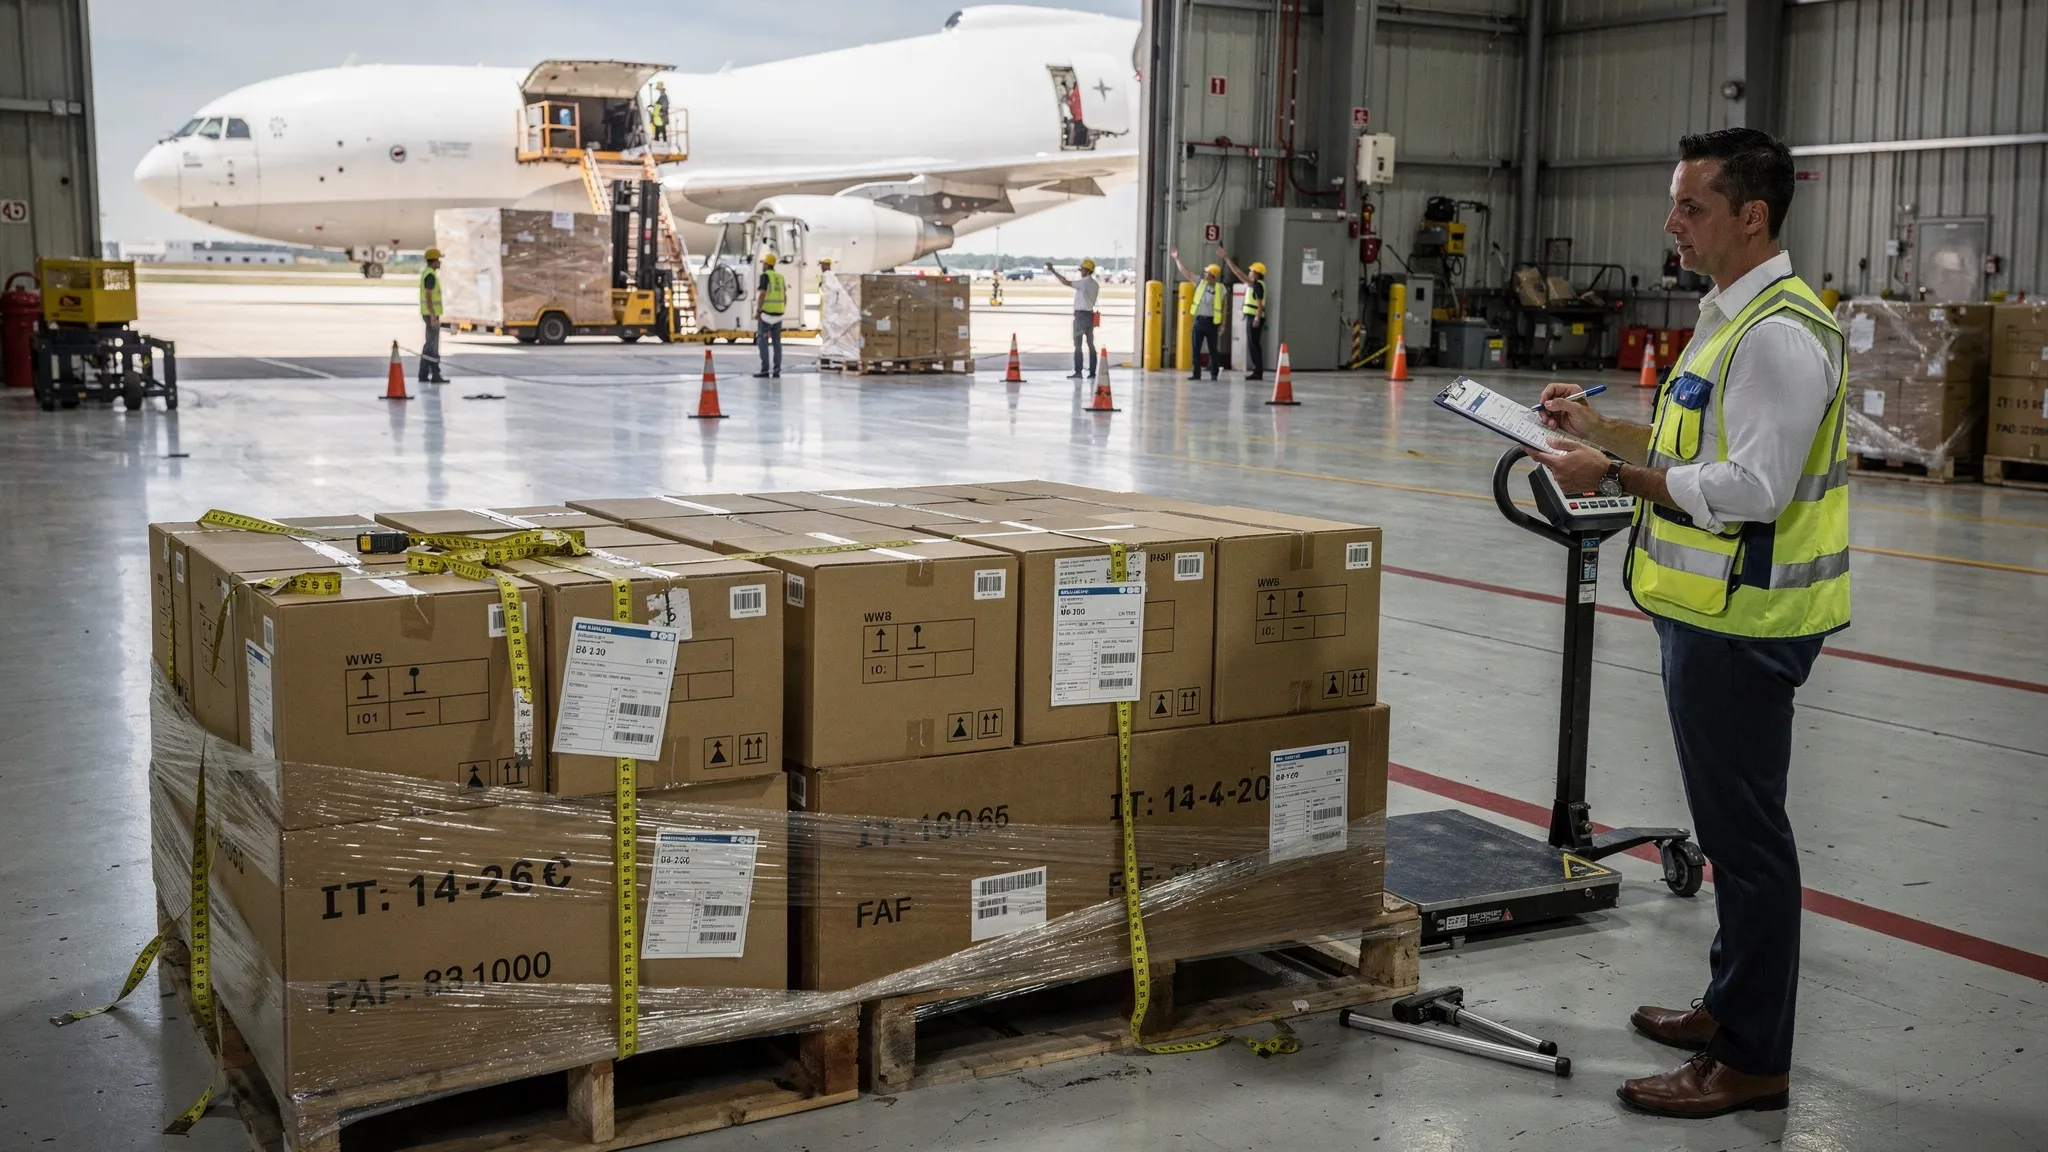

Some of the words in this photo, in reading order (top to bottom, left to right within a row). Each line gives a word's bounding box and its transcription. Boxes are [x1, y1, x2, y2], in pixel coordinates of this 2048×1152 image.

[345, 653, 383, 666] WWS
[321, 879, 391, 921] IT:
[856, 896, 912, 929] FAF
